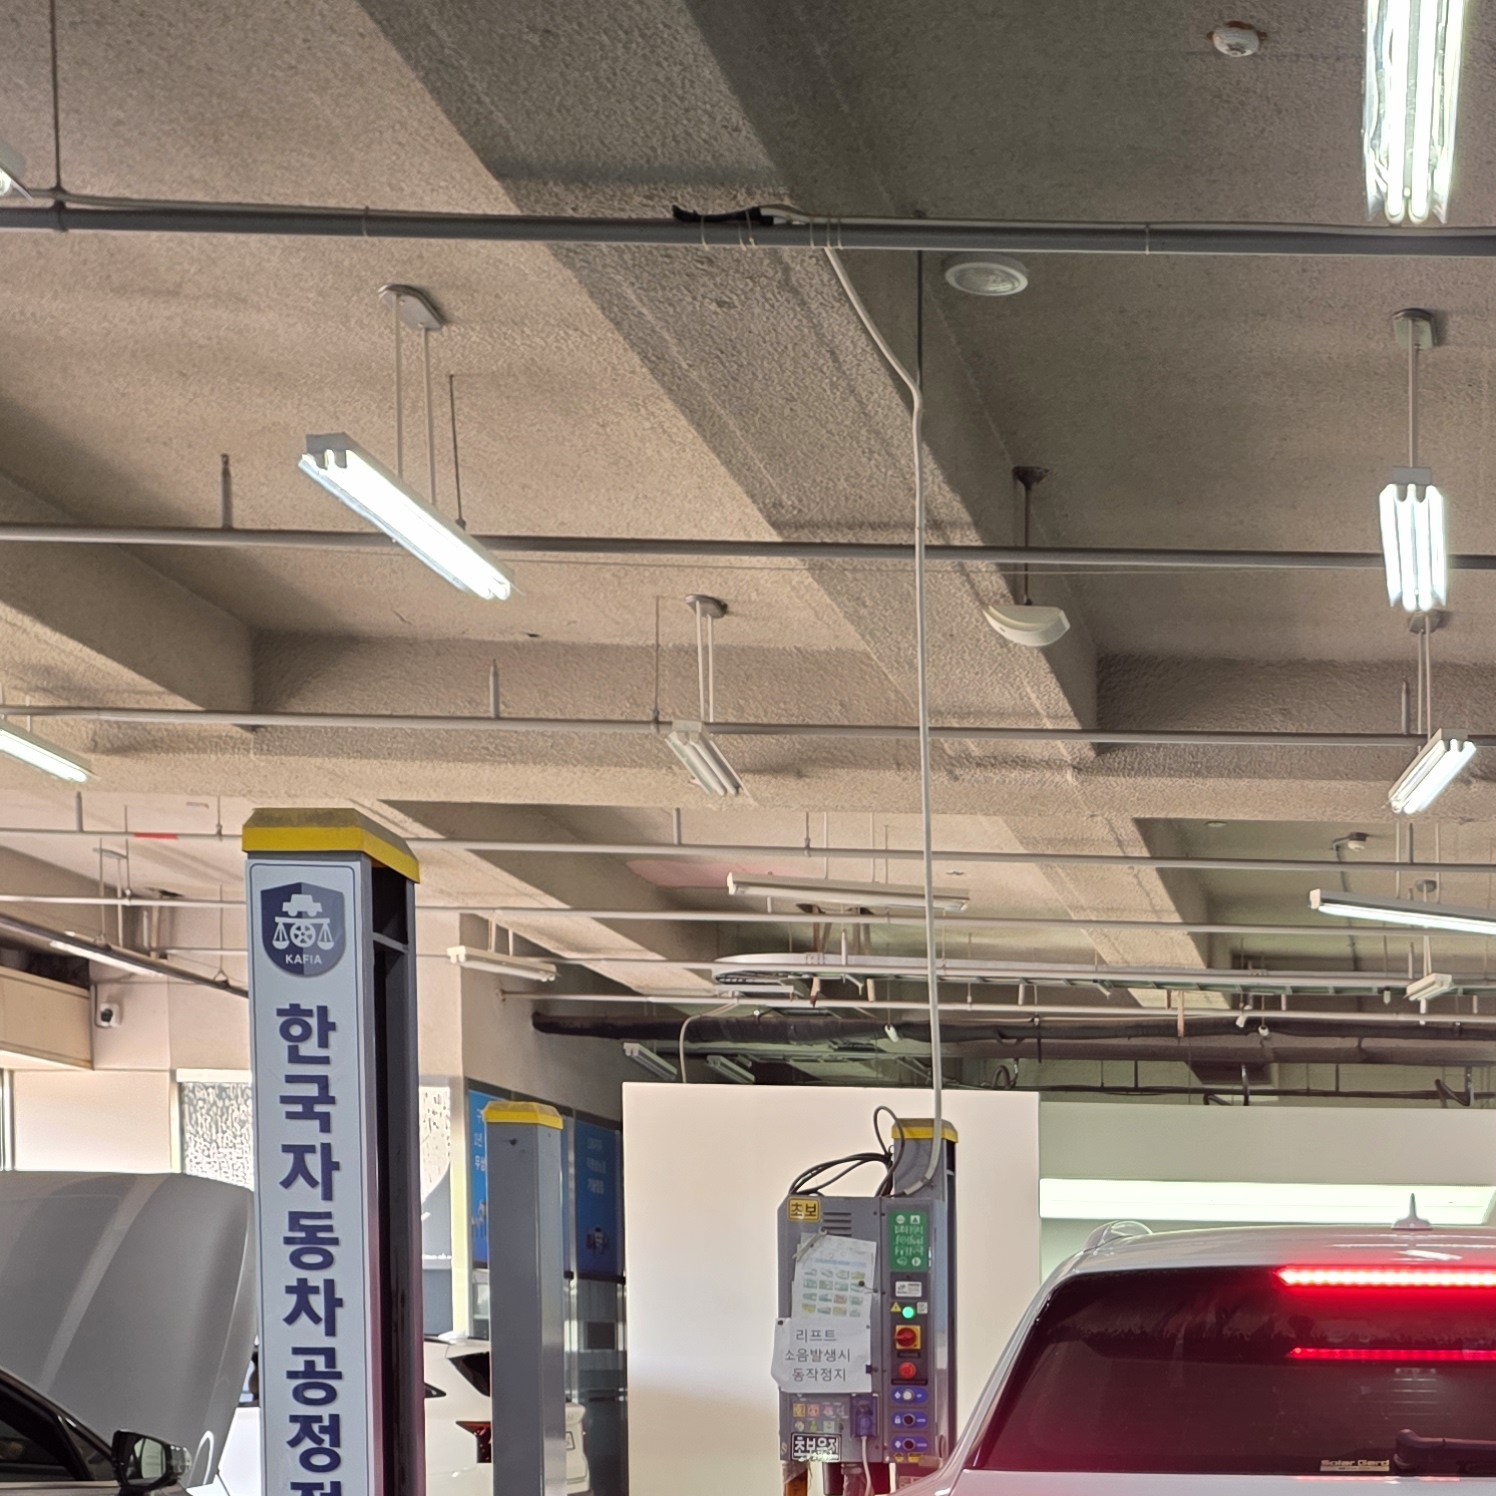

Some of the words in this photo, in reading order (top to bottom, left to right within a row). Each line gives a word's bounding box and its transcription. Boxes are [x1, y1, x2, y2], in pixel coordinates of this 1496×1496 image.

[285, 953, 323, 965] KAFIA
[791, 1202, 817, 1217] 초보
[795, 1329, 837, 1343] 리프트
[784, 1347, 851, 1363] 소음발생시
[791, 1367, 847, 1383] 동작정지
